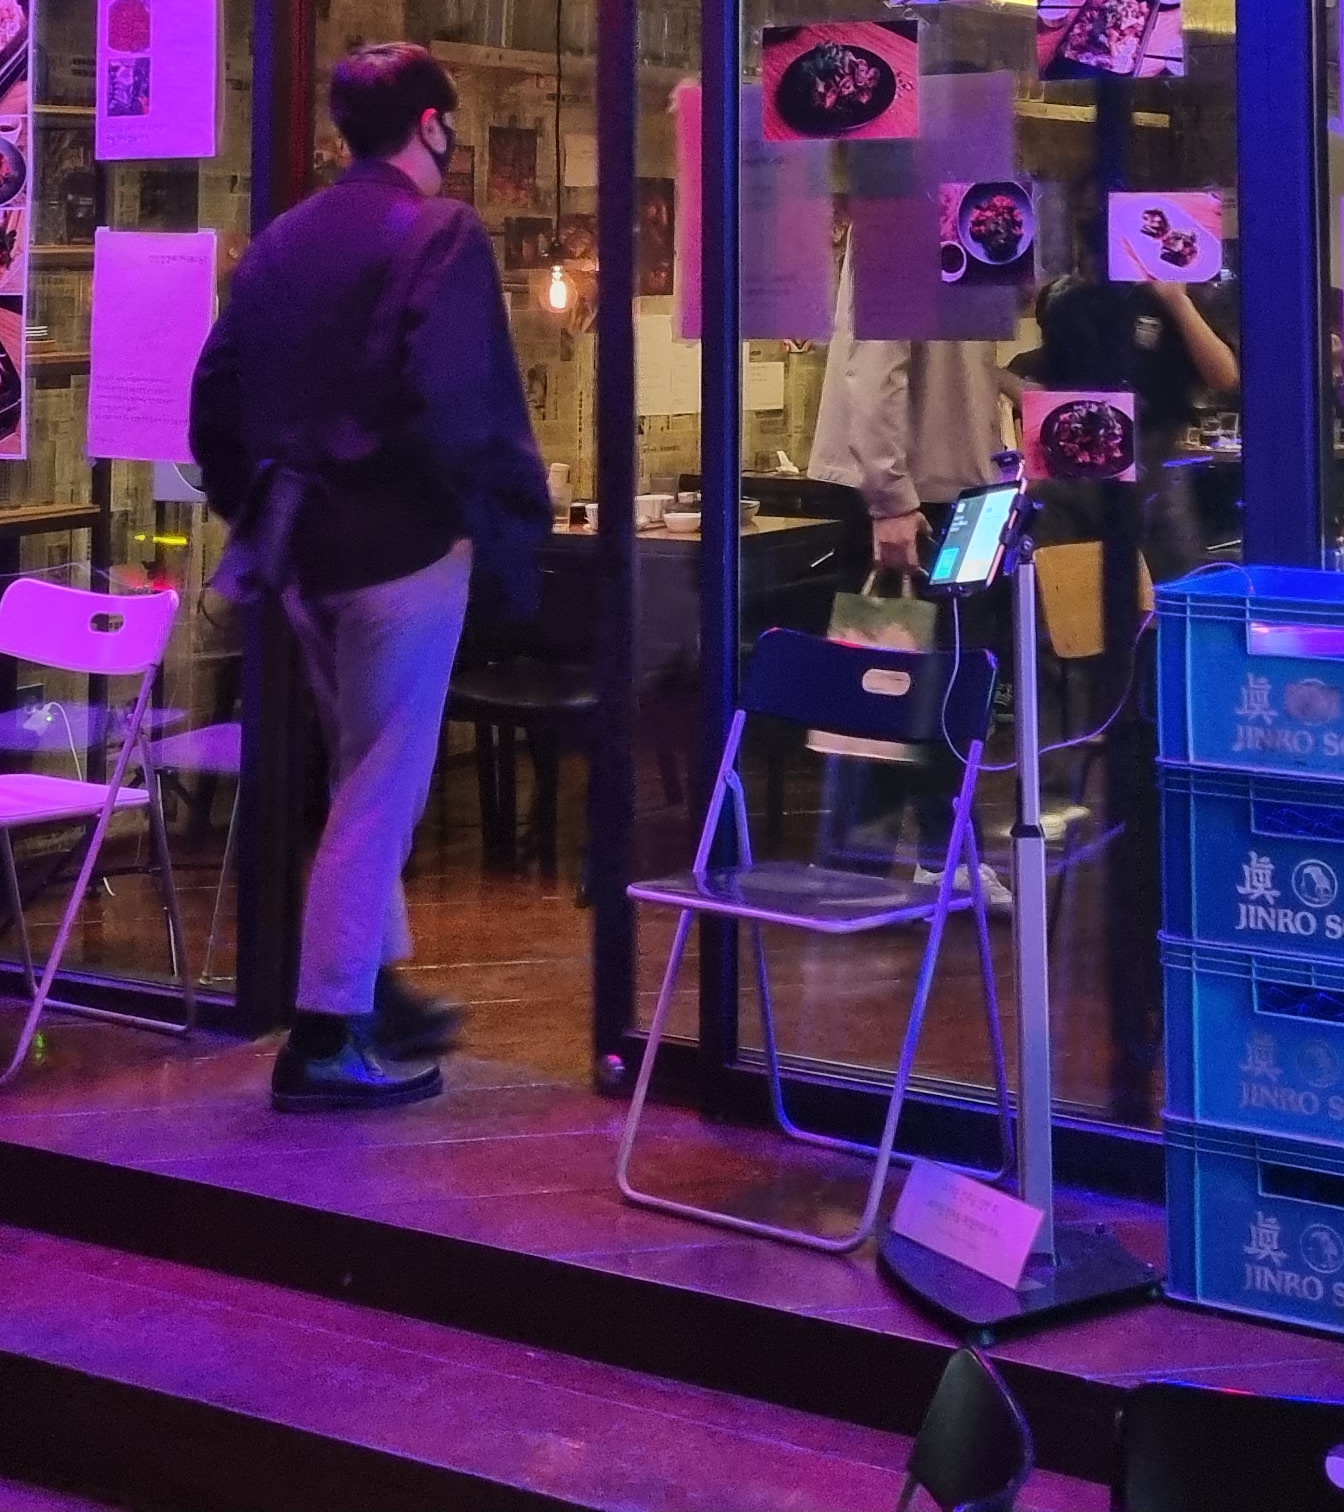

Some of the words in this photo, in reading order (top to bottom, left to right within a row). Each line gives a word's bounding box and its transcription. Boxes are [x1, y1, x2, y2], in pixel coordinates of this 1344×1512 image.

[1233, 726, 1313, 757] JINRO
[1235, 904, 1317, 936] JINRO
[1238, 1082, 1320, 1116] JINRO
[1243, 1262, 1324, 1302] JINRO
